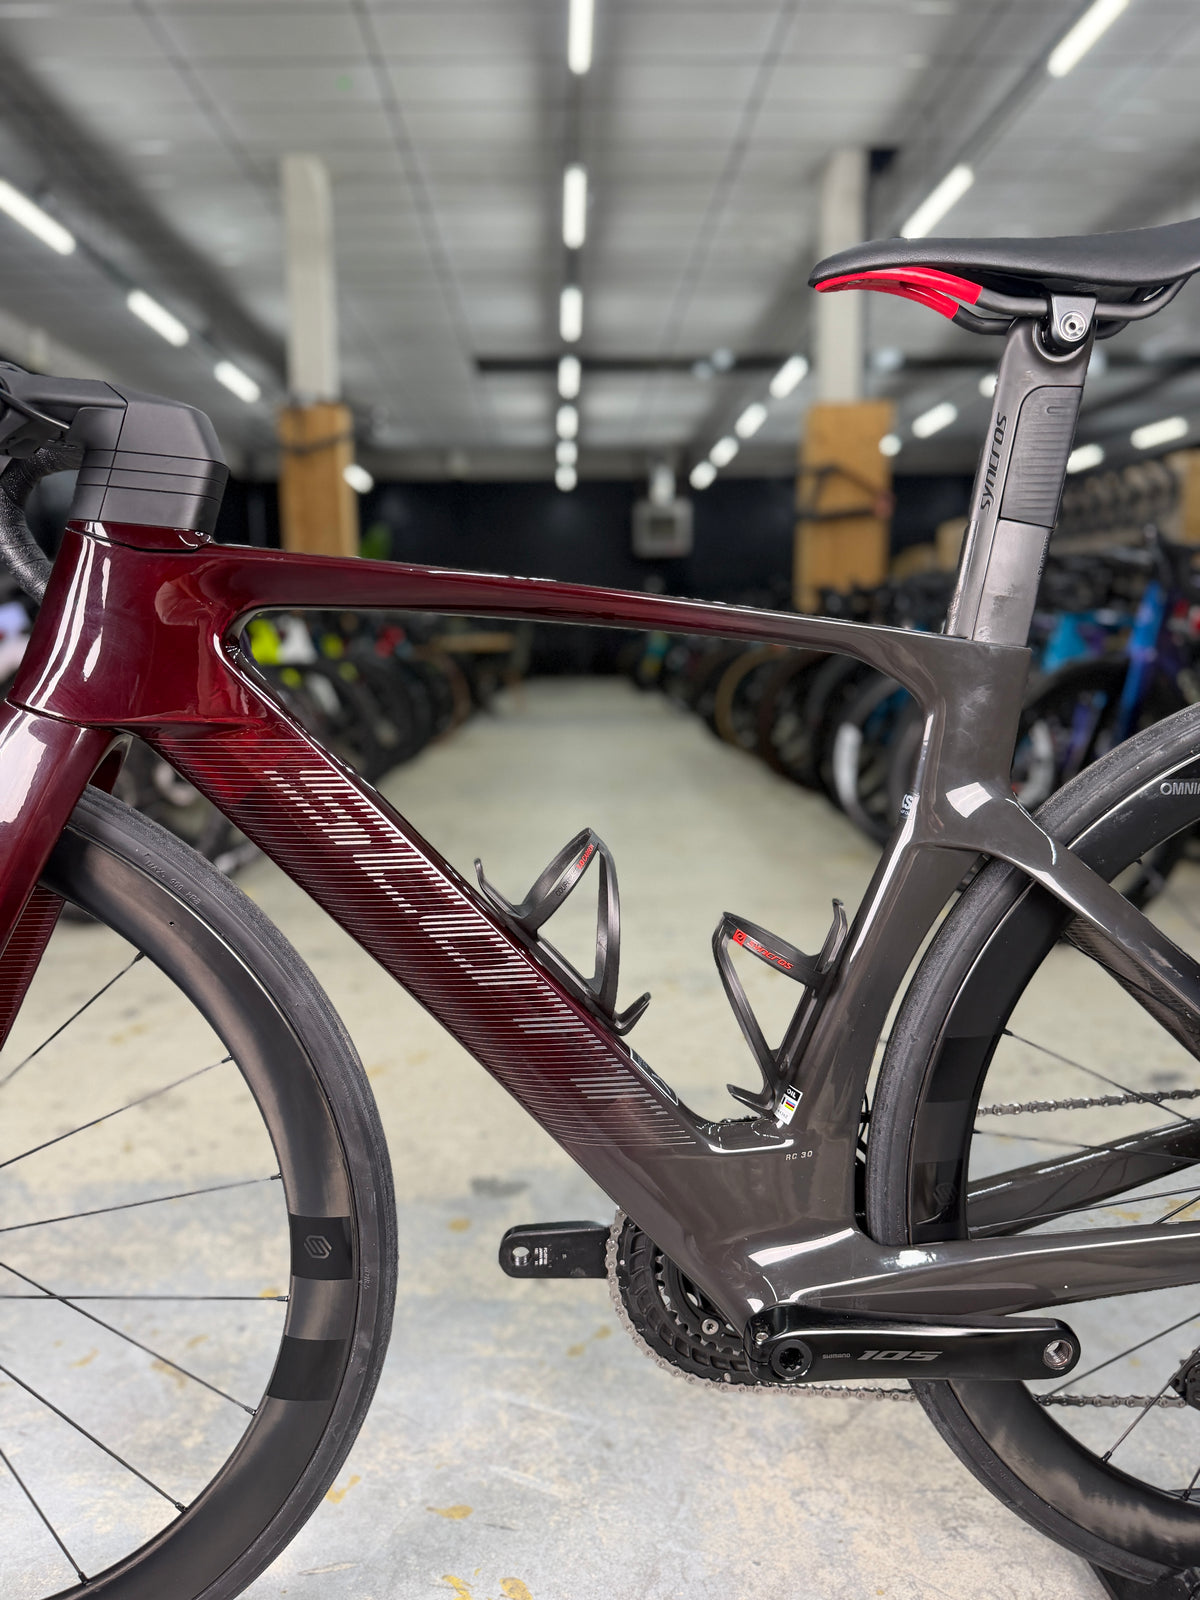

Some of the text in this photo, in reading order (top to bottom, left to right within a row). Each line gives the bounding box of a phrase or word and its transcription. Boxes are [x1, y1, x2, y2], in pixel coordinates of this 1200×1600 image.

[785, 1150, 813, 1161] RC 30
[857, 1350, 943, 1361] 105
